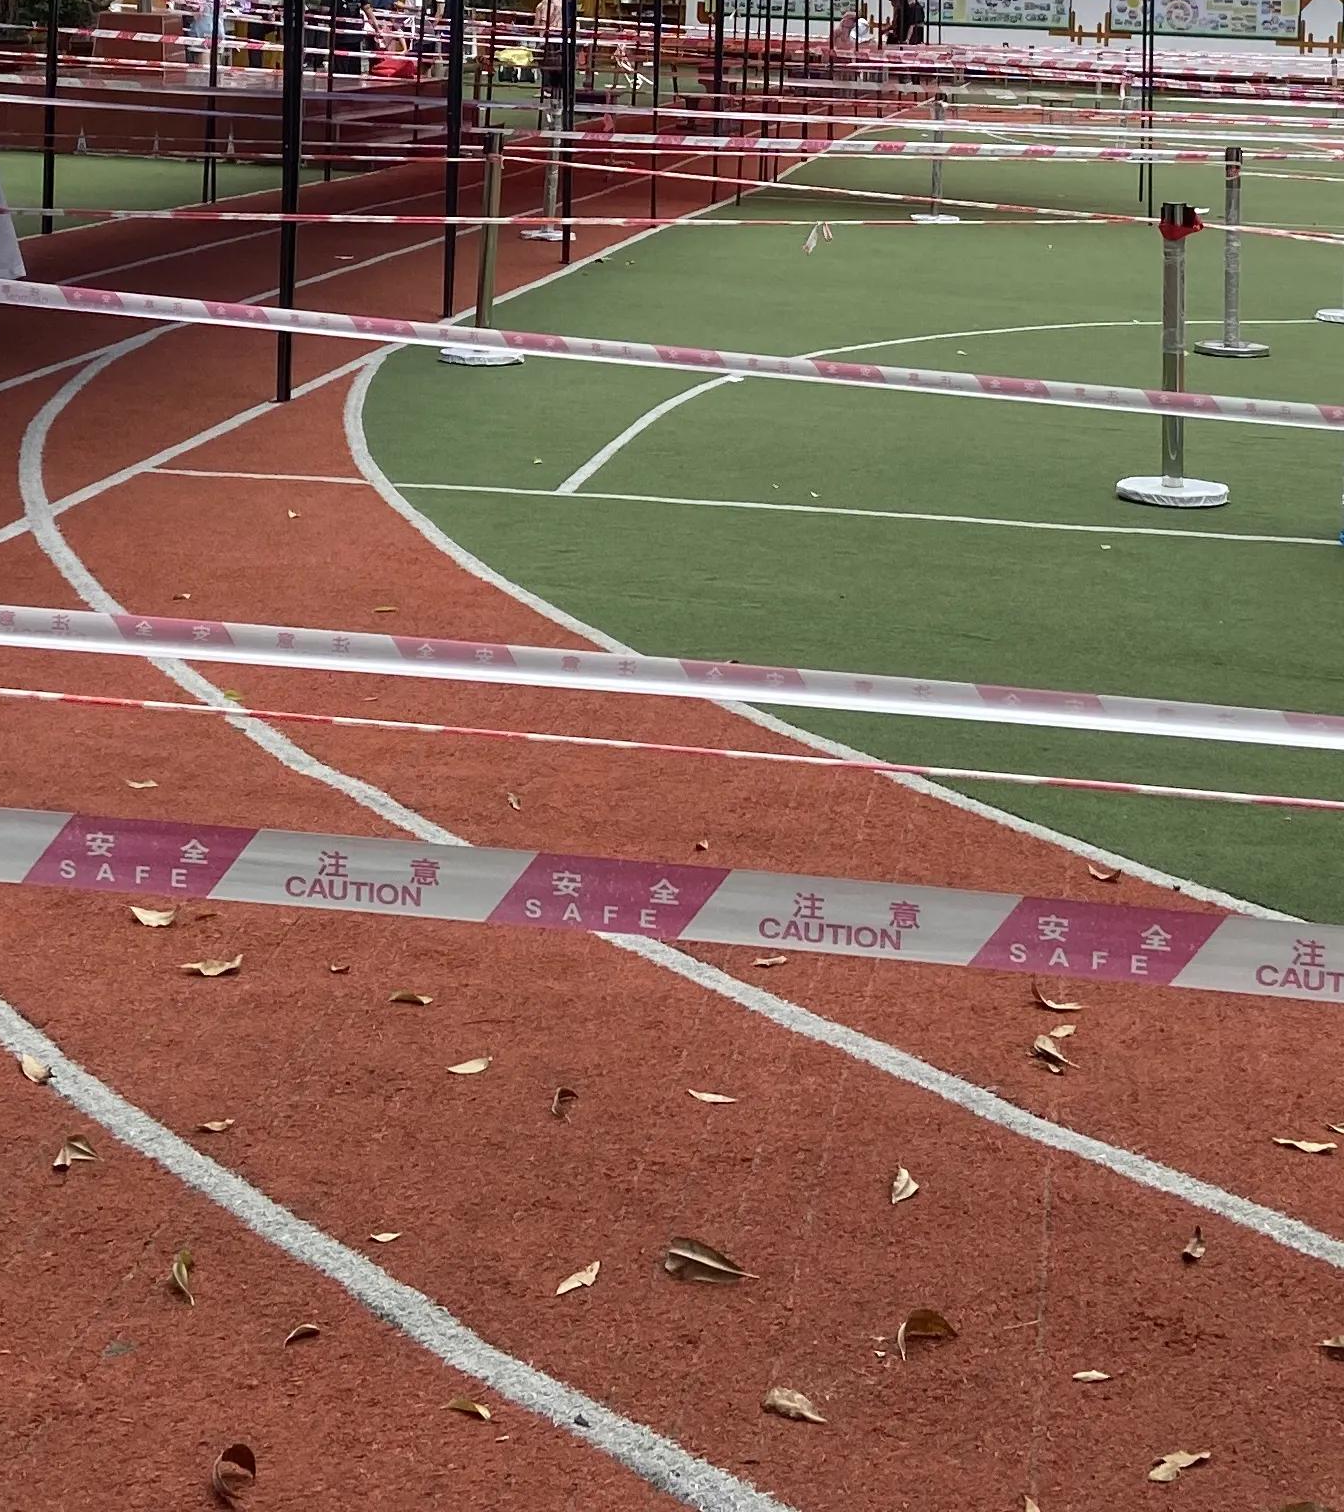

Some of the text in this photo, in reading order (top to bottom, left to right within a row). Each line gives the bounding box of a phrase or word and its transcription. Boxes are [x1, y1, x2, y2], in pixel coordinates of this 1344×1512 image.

[86, 832, 209, 866] 安全
[60, 859, 187, 888] SAFE
[318, 851, 440, 887] 注意
[284, 876, 422, 907] CAUTION
[551, 871, 679, 906] 安全
[525, 899, 660, 929] SAFE
[793, 893, 920, 929] 注意
[758, 917, 901, 950] CAUTION
[1039, 915, 1172, 951] 安全
[1010, 944, 1147, 975] SAFE
